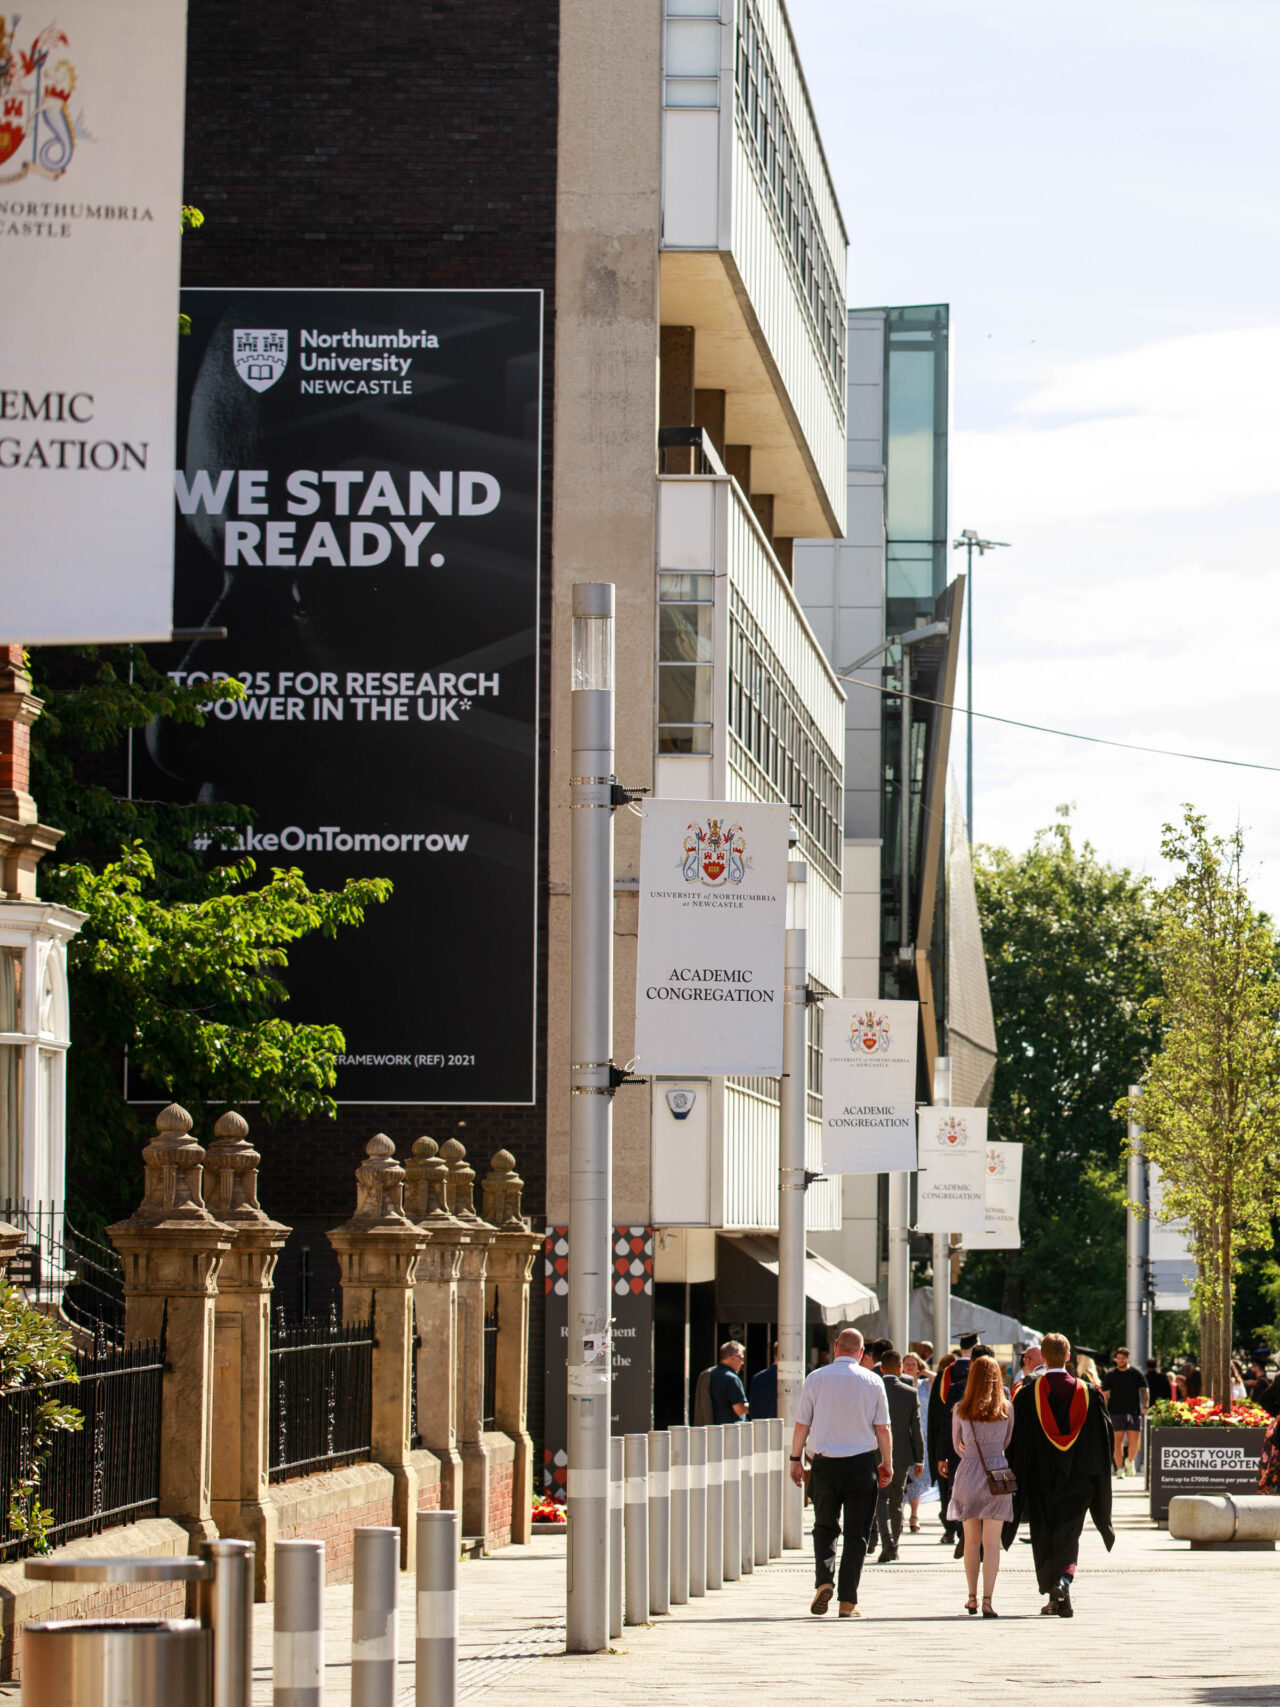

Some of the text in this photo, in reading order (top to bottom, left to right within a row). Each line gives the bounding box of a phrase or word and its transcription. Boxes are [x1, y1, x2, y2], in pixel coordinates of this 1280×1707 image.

[300, 328, 440, 349] Northumbria
[300, 352, 413, 377] University
[300, 379, 413, 395] NEWCASTLE
[174, 469, 501, 516] WE STAND
[224, 520, 446, 568] READY.
[238, 671, 271, 696] 25
[279, 672, 338, 696] FOR
[346, 672, 500, 697] RESEARCH
[313, 697, 344, 722] IN
[350, 697, 409, 722] THE
[650, 890, 702, 899] UNIVERSITY
[713, 893, 777, 902] NORTHUMBRIA
[692, 900, 744, 909] NEWCASTLE
[668, 967, 753, 983] ACADEMIC
[646, 986, 775, 1003] CONGREGATION
[414, 1054, 445, 1068] (REF)
[448, 1054, 475, 1066] 2021
[842, 1106, 895, 1115] ACADEMIC
[828, 1118, 910, 1128] CONGREGATION
[922, 1192, 981, 1200] CONGREGATION
[612, 1354, 632, 1366] the
[1163, 1449, 1242, 1459] BOOST YOUR
[1163, 1459, 1260, 1469] EARNING POTEN
